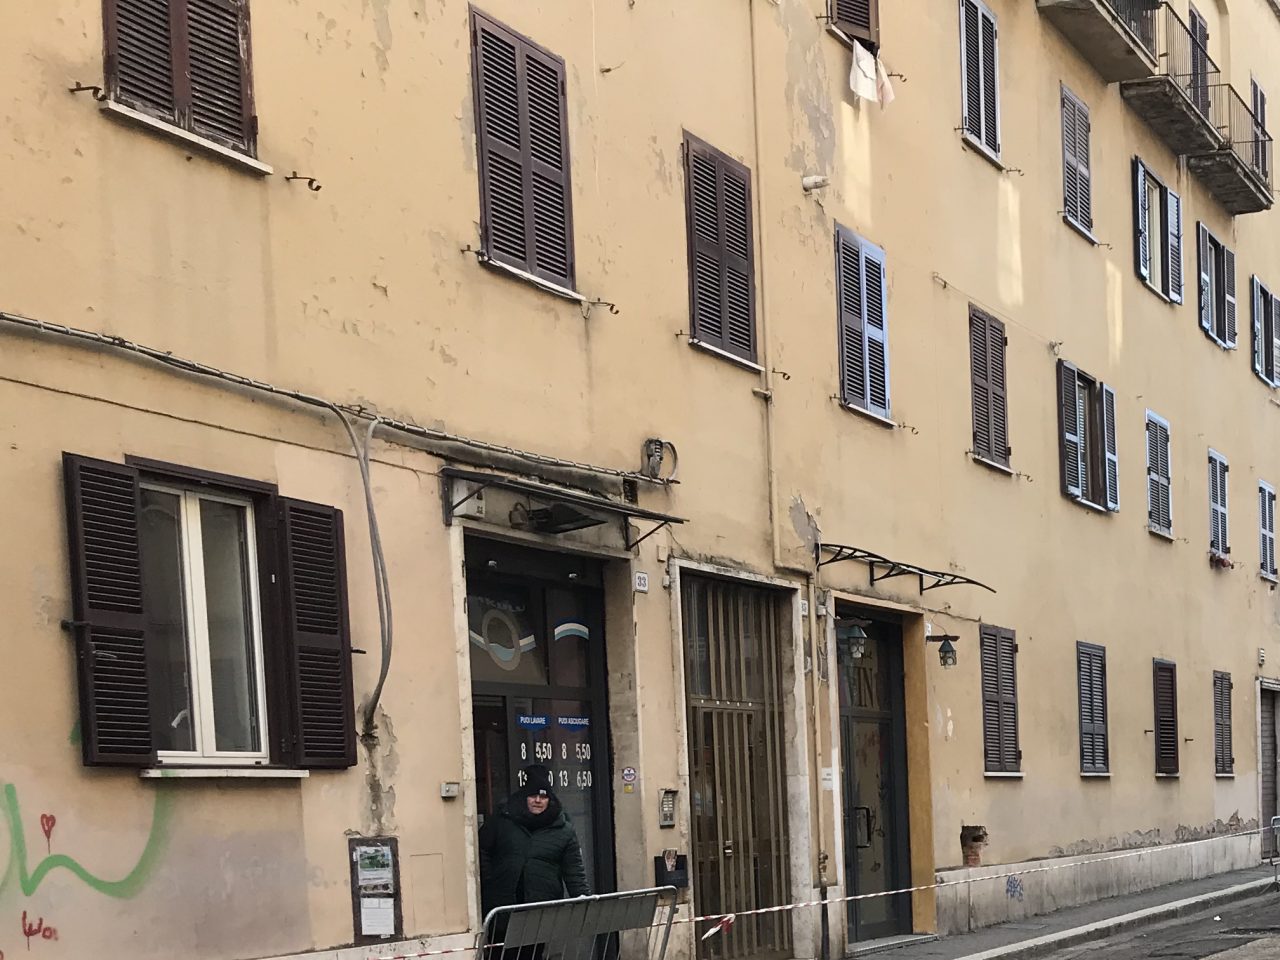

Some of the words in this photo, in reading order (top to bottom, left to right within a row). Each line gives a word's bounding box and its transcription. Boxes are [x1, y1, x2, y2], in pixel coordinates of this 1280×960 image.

[521, 742, 527, 760] 8
[535, 742, 552, 763] 5,50
[561, 742, 567, 760] 8
[575, 743, 591, 763] 5,50
[558, 770, 569, 787] 13
[576, 770, 592, 790] 6,50
